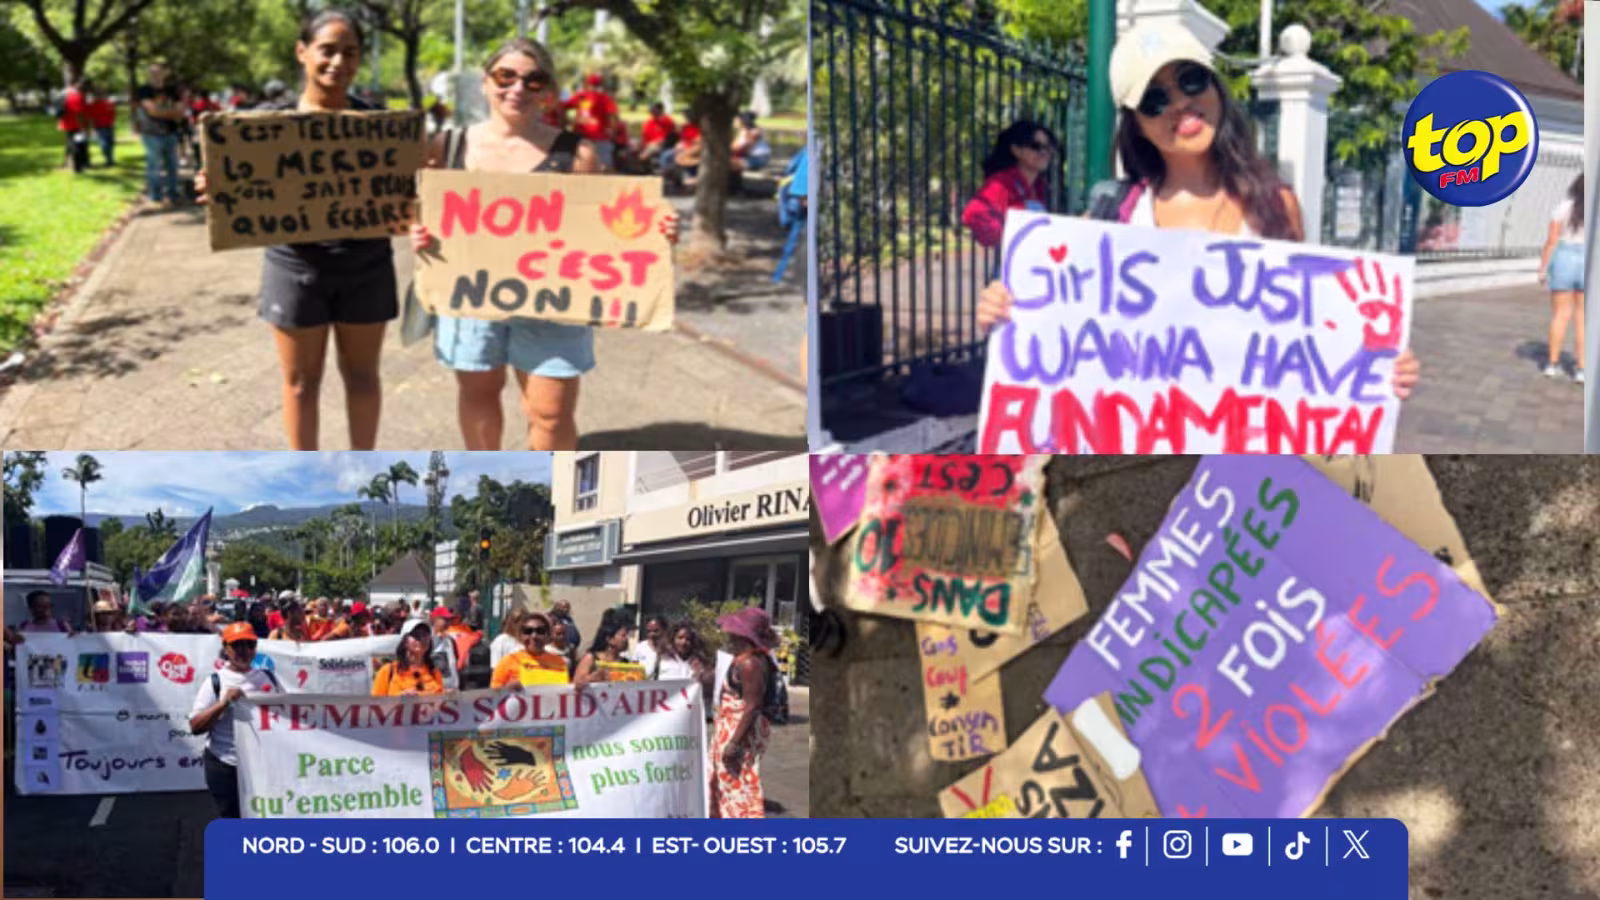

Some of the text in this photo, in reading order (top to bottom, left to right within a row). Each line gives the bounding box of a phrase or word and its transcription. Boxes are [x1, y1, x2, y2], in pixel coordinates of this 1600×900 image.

[440, 188, 565, 238] NON
[517, 239, 660, 291] C'EST
[449, 270, 571, 313] NON
[1001, 318, 1400, 401] WANNA HAVE
[687, 500, 751, 529] Olivier
[1086, 470, 1237, 672] FEMMES
[258, 698, 460, 732] FEMMES
[474, 688, 673, 724] SOLID'AIR
[1170, 682, 1234, 751] 2
[58, 750, 166, 781] Toujours
[297, 752, 376, 779] Parce
[572, 741, 626, 761] nous
[250, 783, 423, 818] qu'ensemble
[590, 766, 641, 795] plus
